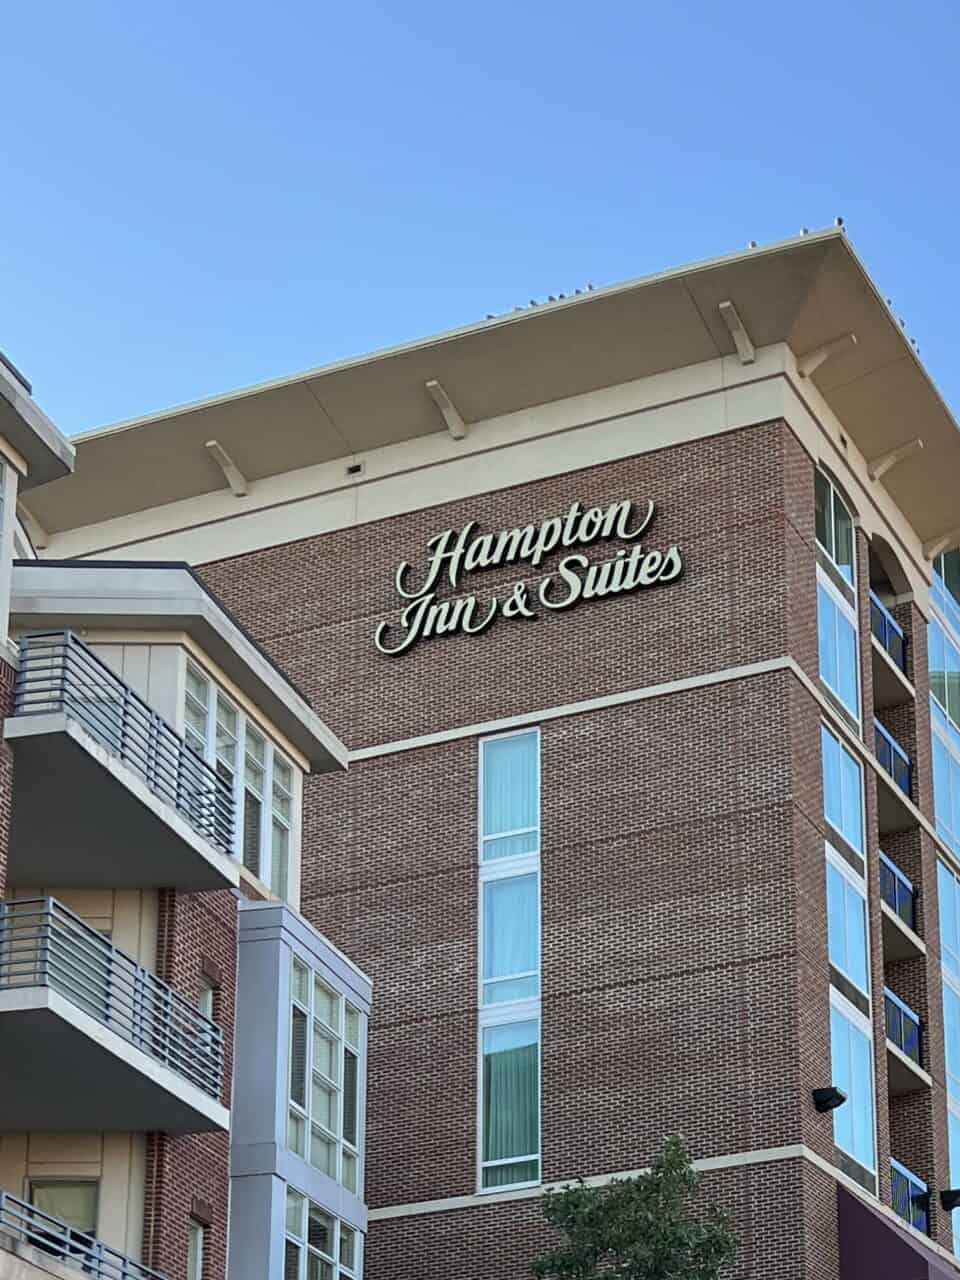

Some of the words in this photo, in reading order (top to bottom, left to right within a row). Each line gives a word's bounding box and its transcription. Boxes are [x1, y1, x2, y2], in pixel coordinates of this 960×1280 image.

[374, 593, 497, 655] Inn
[502, 582, 535, 617] &
[539, 544, 682, 609] Suites
[396, 499, 654, 598] Hampton
